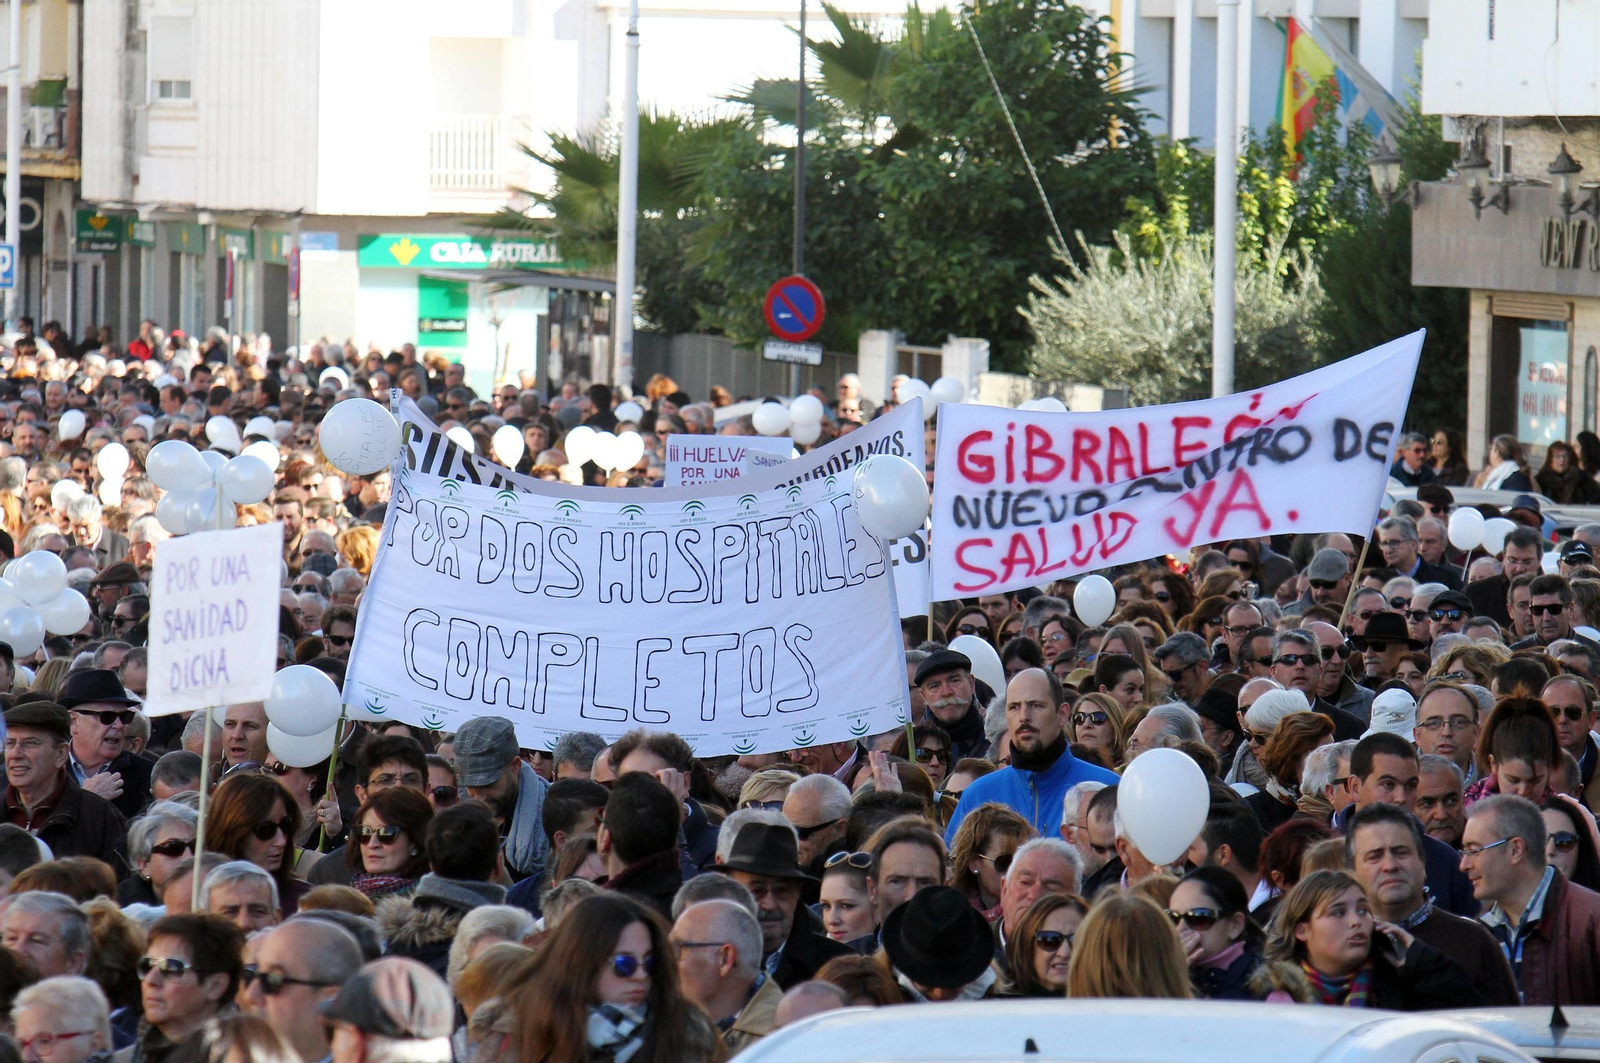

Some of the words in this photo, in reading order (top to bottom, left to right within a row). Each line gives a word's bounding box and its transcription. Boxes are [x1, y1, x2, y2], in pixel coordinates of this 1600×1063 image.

[430, 242, 487, 263] CAJA
[681, 466, 705, 479] POR
[714, 467, 741, 479] UNA
[953, 488, 1108, 530] NUEVO
[1333, 417, 1395, 464] DE
[166, 557, 201, 595] POR
[210, 553, 250, 587] UNA
[477, 514, 584, 598] DOS
[598, 493, 886, 604] HOSPITALES
[954, 511, 1139, 592] SALUD
[403, 608, 819, 724] COMPLETOS
